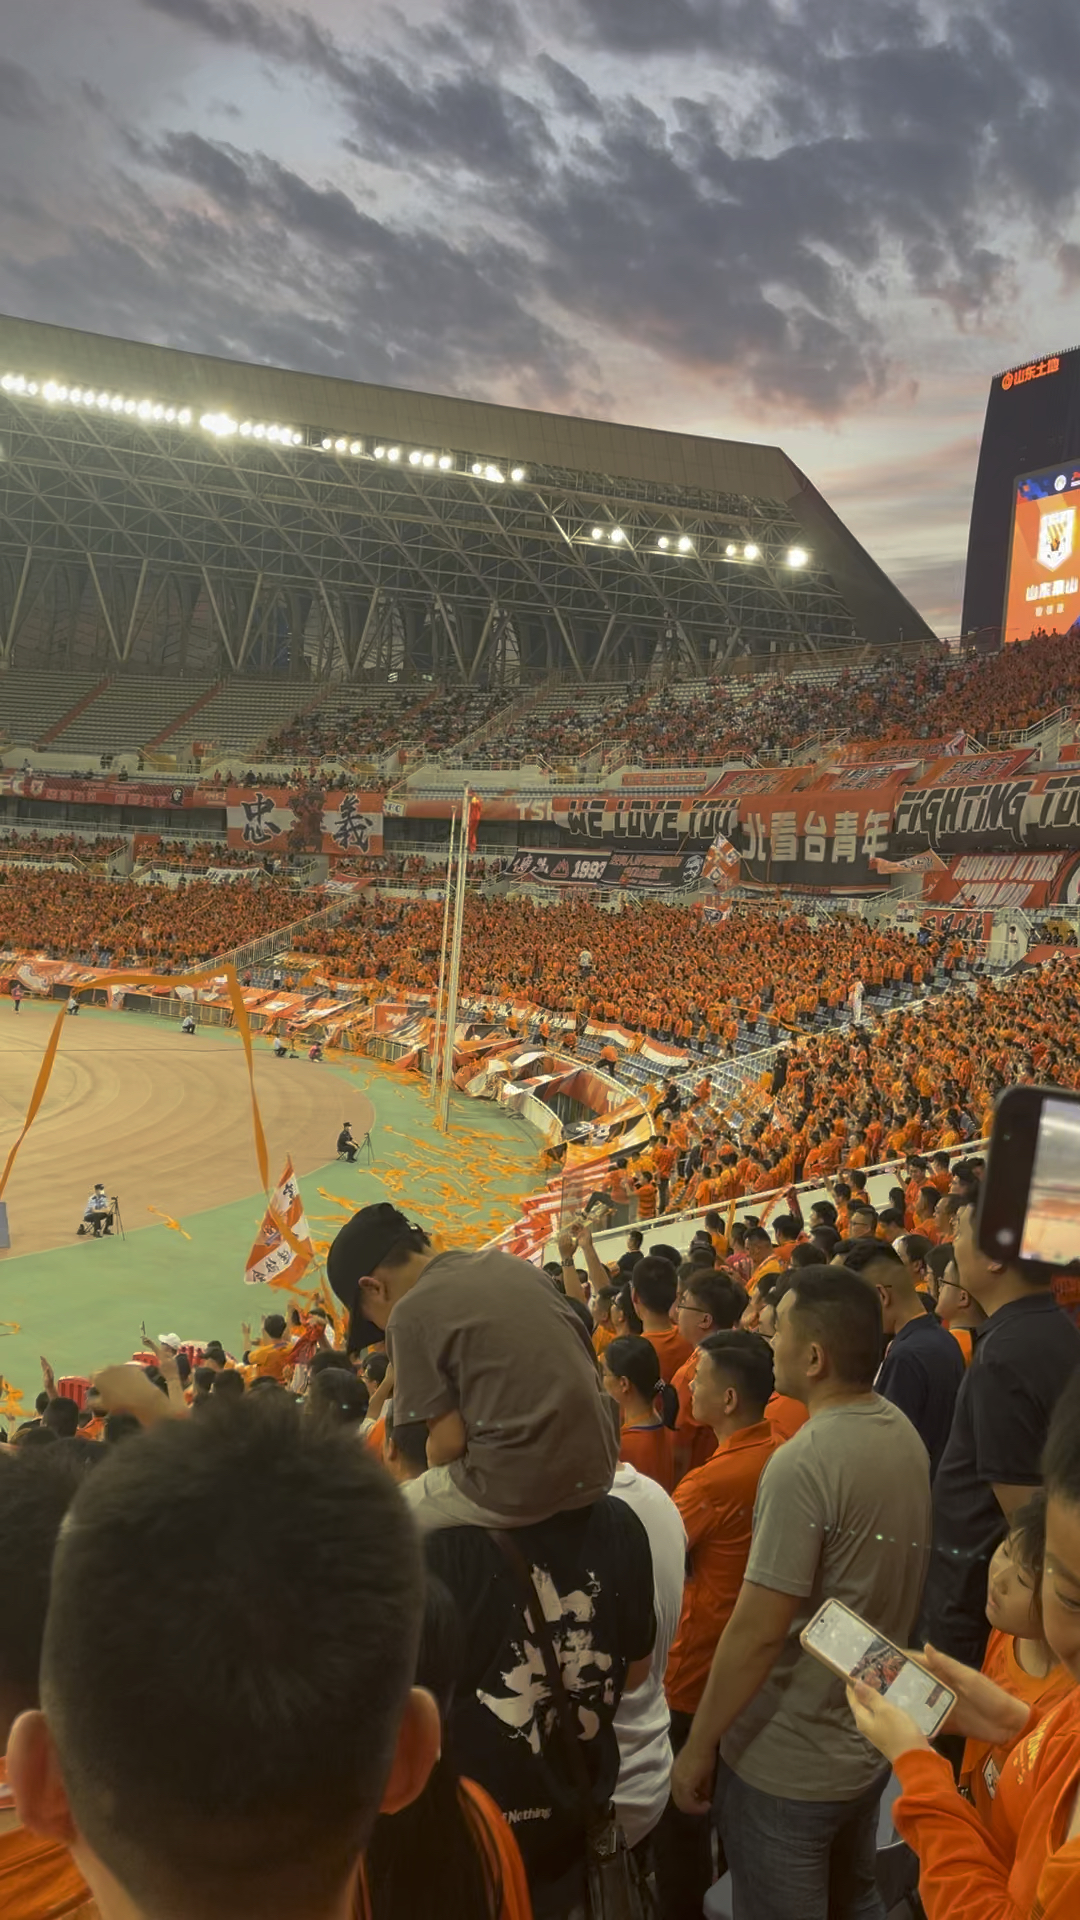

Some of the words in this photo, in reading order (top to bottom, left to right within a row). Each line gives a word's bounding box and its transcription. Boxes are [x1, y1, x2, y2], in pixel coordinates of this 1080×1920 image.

[1013, 357, 1060, 386] 山东土地
[241, 791, 282, 846] 忠
[332, 793, 374, 852] 義
[568, 799, 609, 838] WE
[613, 798, 682, 840] LOVE
[741, 808, 891, 864] 北看台青年
[507, 1807, 553, 1825] Nothing
